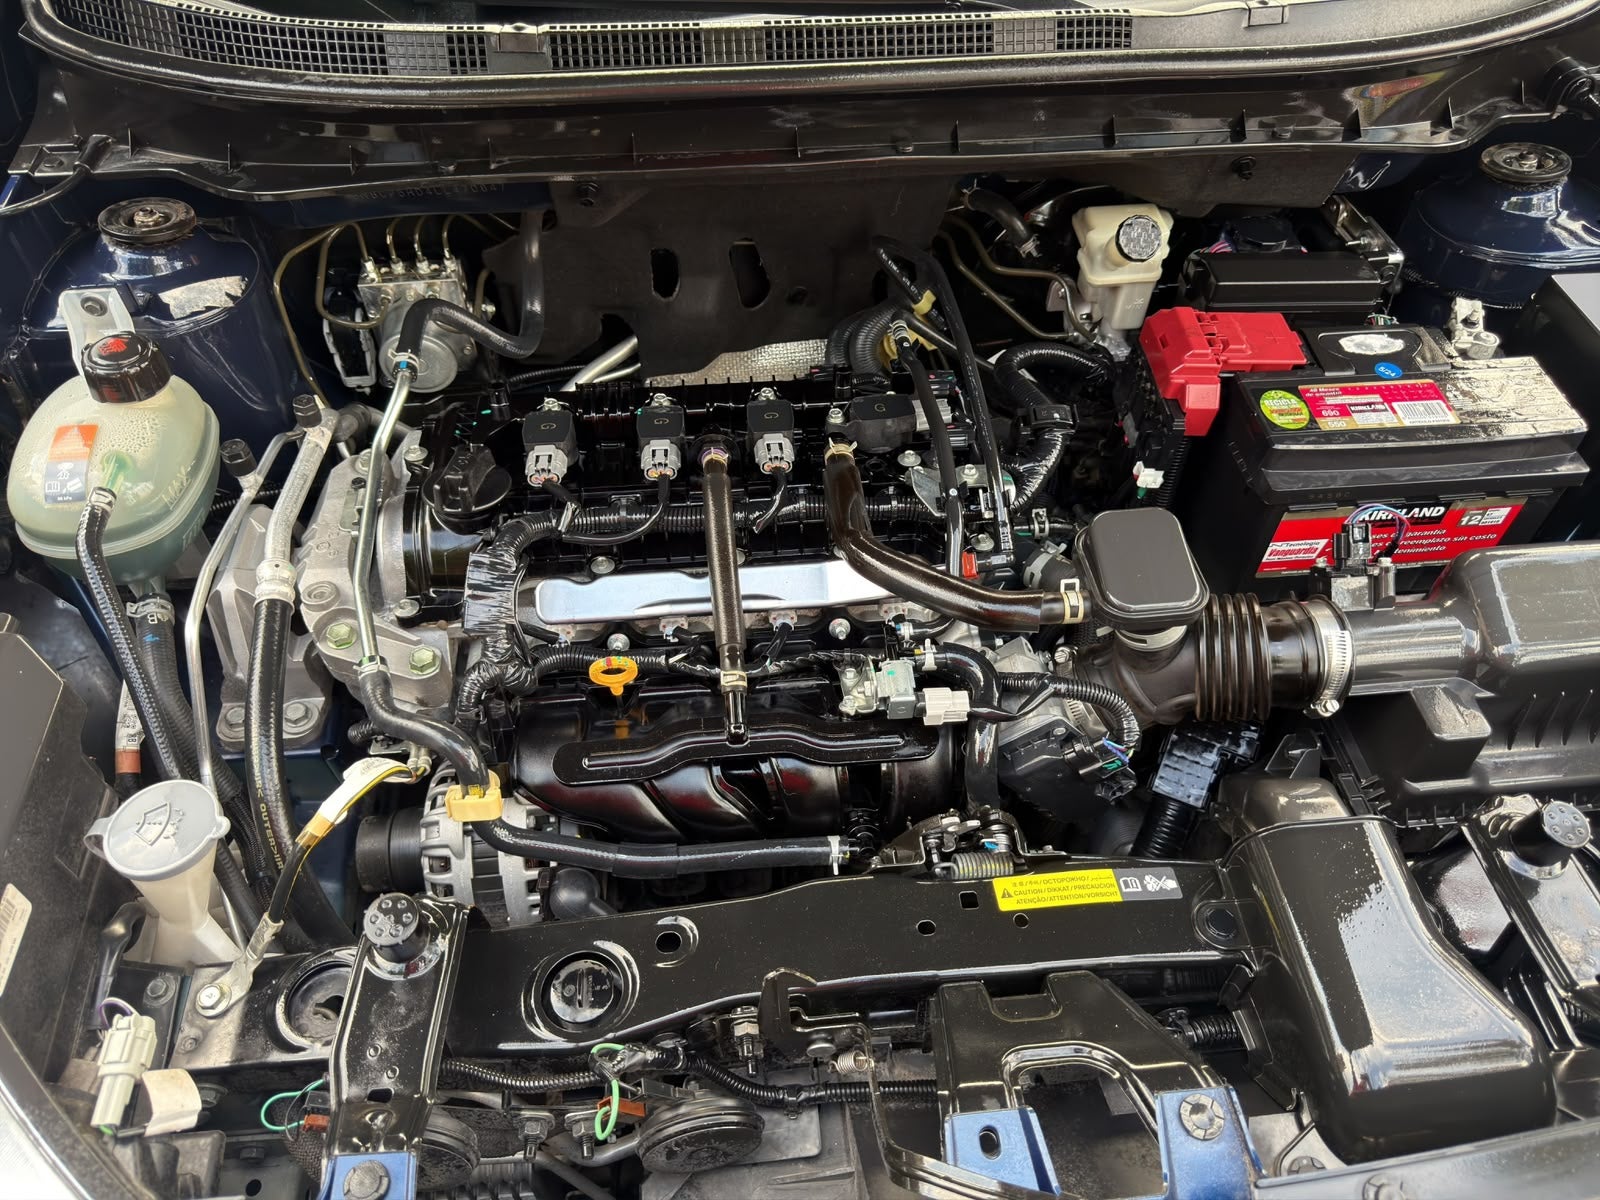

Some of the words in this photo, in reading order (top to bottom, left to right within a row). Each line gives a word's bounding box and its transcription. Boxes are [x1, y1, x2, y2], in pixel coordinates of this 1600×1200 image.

[1460, 515, 1481, 525] 12
[1399, 537, 1450, 545] reemplazo
[1268, 546, 1318, 557] Vanguardia
